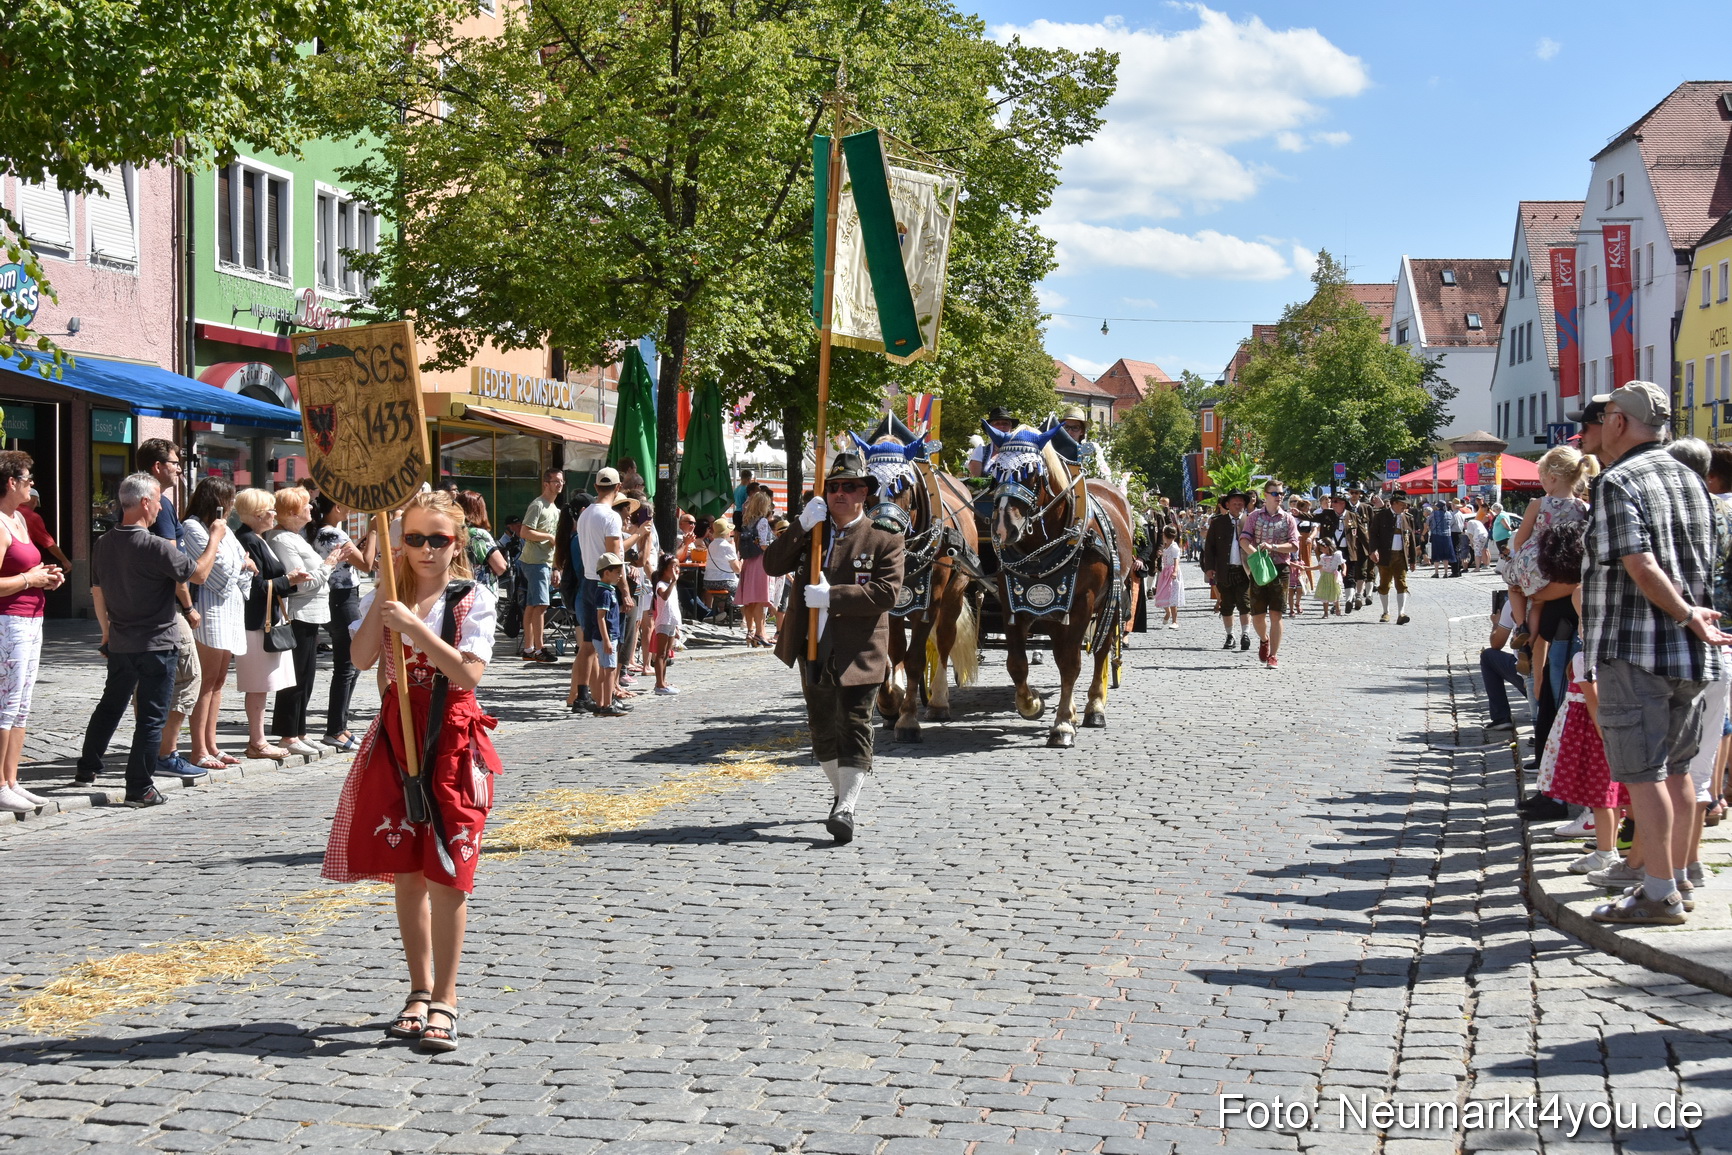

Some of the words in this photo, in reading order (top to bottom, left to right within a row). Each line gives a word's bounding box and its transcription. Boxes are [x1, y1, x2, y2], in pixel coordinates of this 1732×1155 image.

[1607, 230, 1622, 268] K&L
[1710, 327, 1728, 348] HOTEL
[479, 367, 512, 401] LEDER
[95, 418, 113, 437] Essig
[362, 400, 414, 444] 1433
